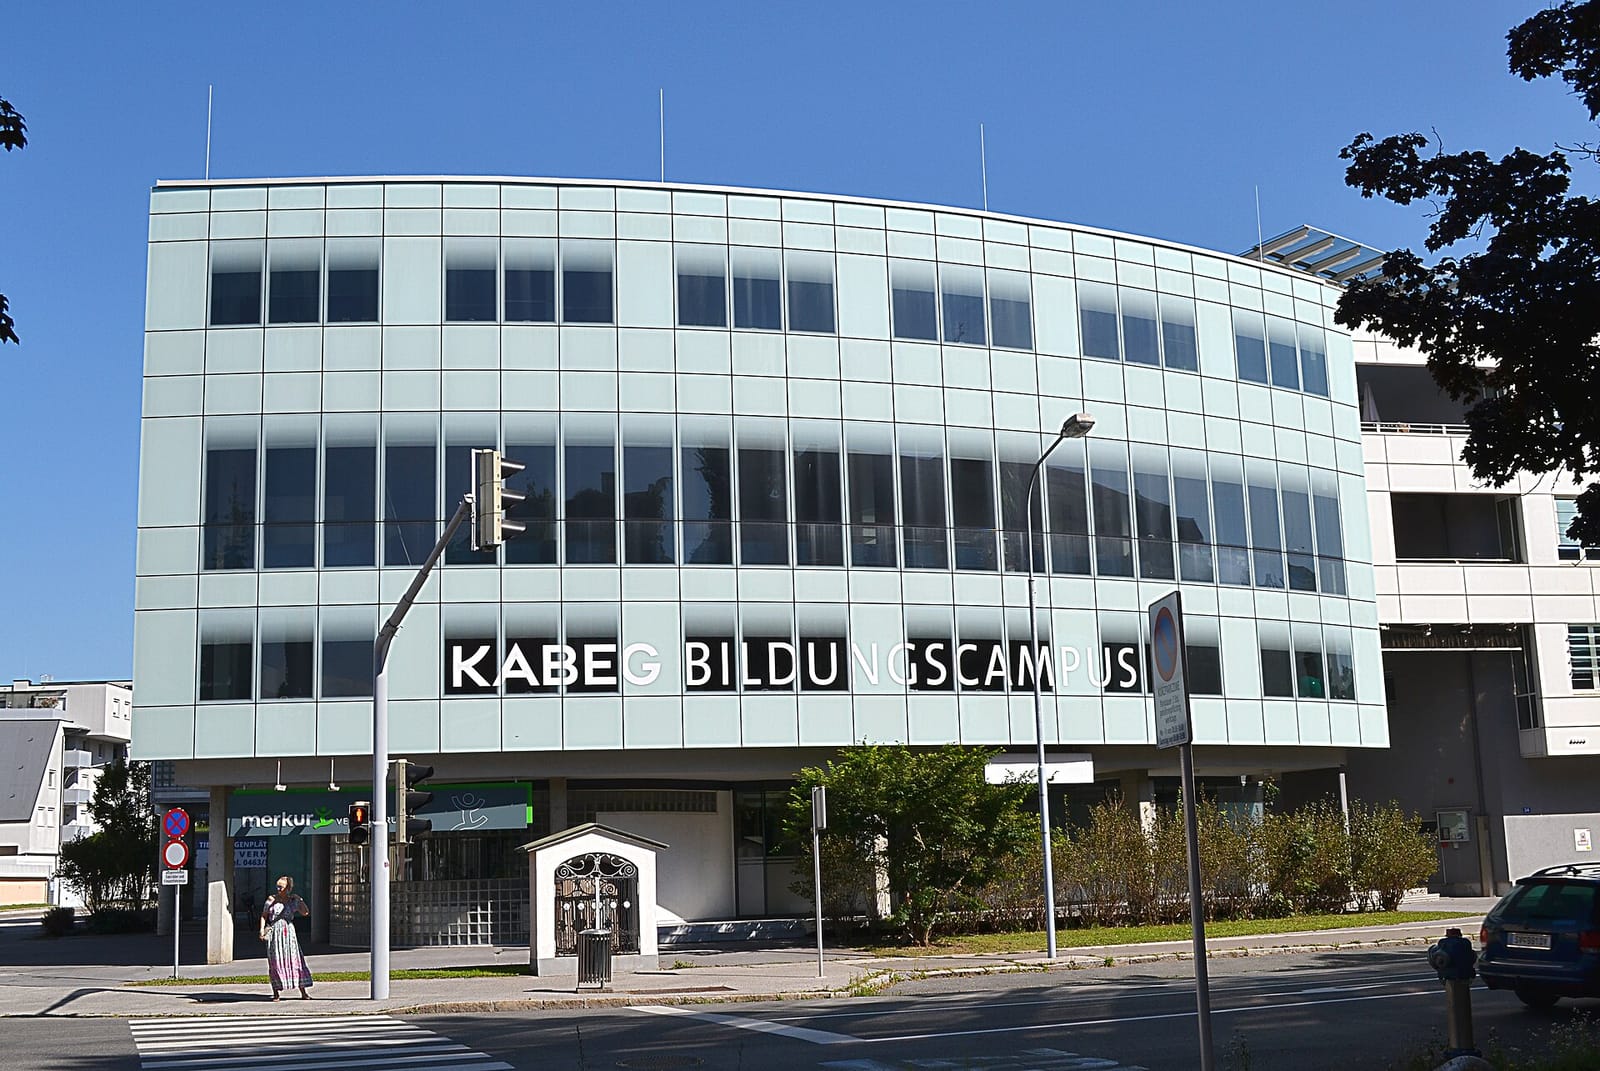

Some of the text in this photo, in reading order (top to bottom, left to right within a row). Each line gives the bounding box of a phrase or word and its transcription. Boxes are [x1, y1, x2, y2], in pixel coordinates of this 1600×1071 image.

[452, 641, 1137, 688] KABEG BILDUNGSCAMPUS
[242, 811, 313, 828] merkur
[243, 859, 267, 867] 0463/
